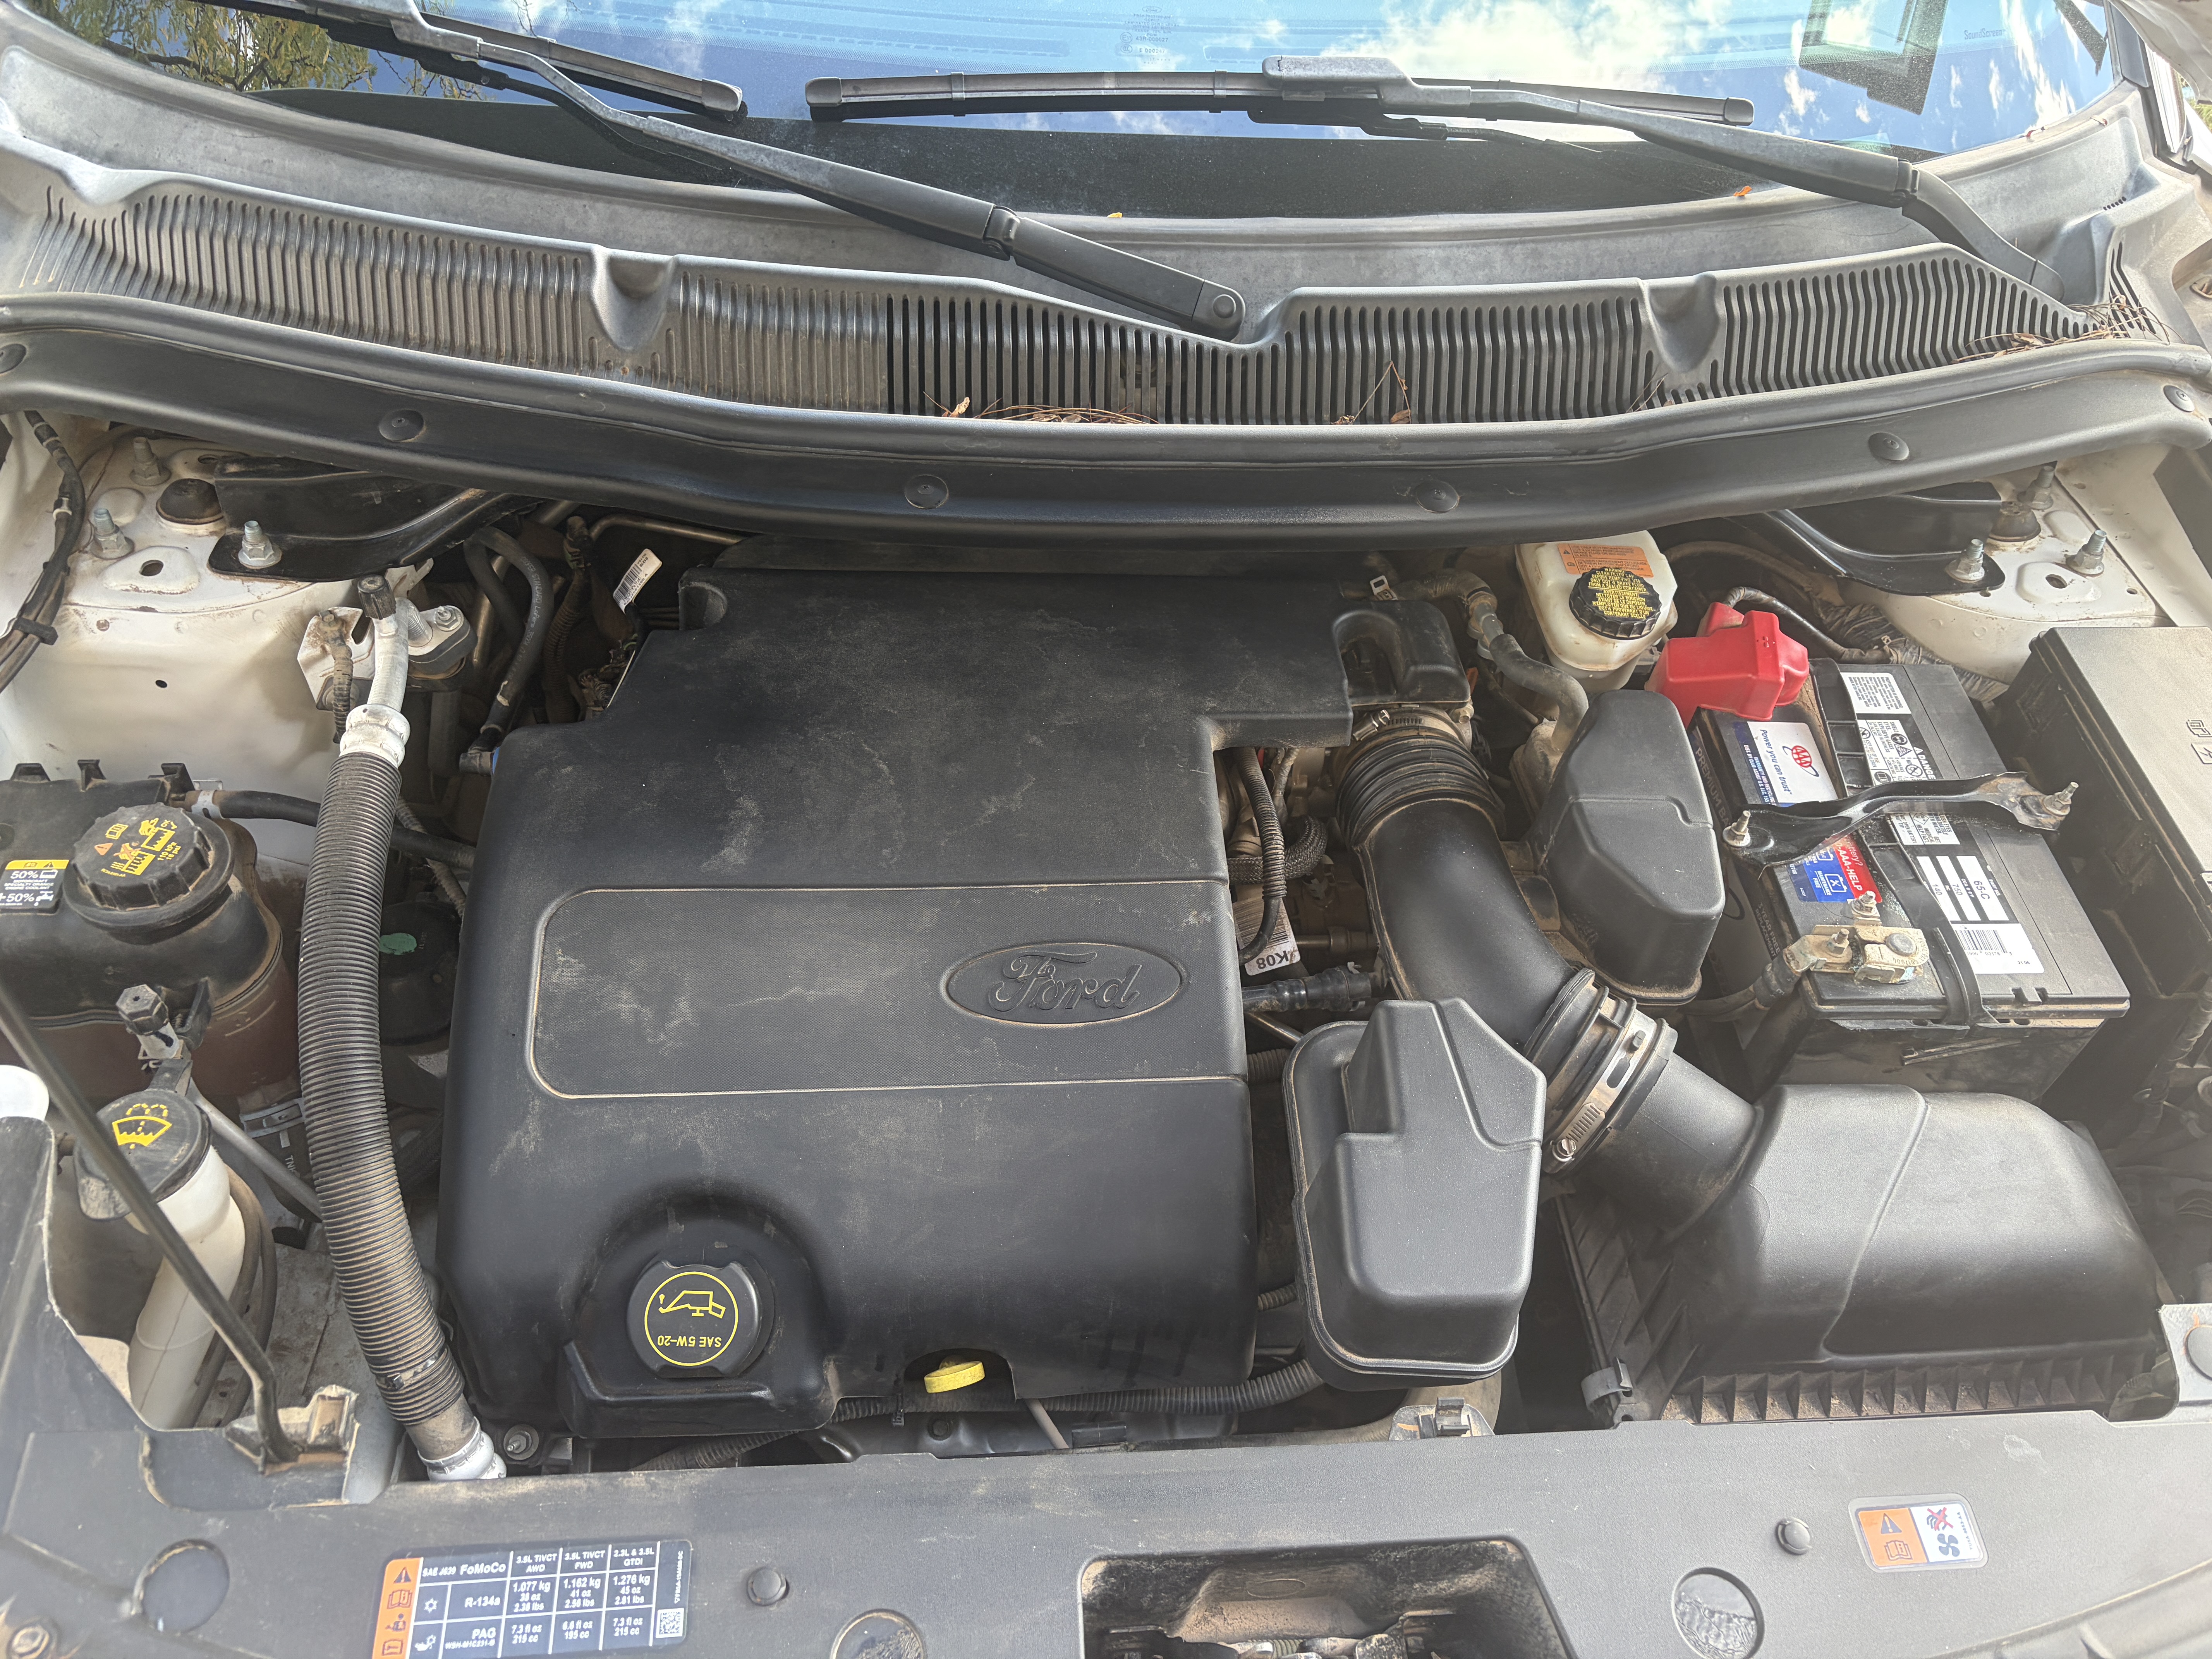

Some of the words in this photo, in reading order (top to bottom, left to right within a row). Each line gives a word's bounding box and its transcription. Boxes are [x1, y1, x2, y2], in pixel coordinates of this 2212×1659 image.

[1889, 722, 1899, 732] SHIELD
[1877, 722, 1889, 738] EXPLOSIVE
[1886, 739, 1894, 750] GASES
[1760, 730, 1772, 750] Power
[1766, 750, 1778, 763] you
[1774, 764, 1783, 775] can
[1792, 746, 1812, 768] AAA
[1918, 755, 1936, 780] DANGE
[1696, 747, 1722, 807] PREMIUM
[161, 819, 171, 828] OK
[1917, 824, 1925, 833] HELP
[1934, 814, 1949, 835] MMEDIATELY
[1944, 824, 1952, 832] EYES
[1907, 830, 1917, 843] BATTERY
[1924, 828, 1935, 843] MEDICAL
[158, 851, 169, 860] 110
[165, 842, 177, 852] kPa
[172, 845, 181, 854] psi
[1813, 878, 1821, 888] FREE
[1817, 871, 1832, 896] MAINTENANCE
[1989, 879, 1997, 891] PART
[1932, 884, 1942, 895] 140
[1952, 884, 1963, 895] 750
[1973, 881, 1990, 899] 65-C
[1755, 908, 1776, 957] REPLACEMENT
[1760, 908, 1772, 930] YEAR
[1769, 931, 1781, 953] FREE
[1257, 950, 1289, 969] K08
[988, 951, 1143, 1012] Ford
[658, 1335, 696, 1347] 5W-20
[699, 1336, 722, 1348] SAE
[565, 1552, 580, 1560] 3.5L
[613, 1549, 630, 1557] 2.3L
[639, 1547, 654, 1556] 3.5L
[516, 1555, 532, 1564] 3.5L
[575, 1561, 593, 1570] FWD
[422, 1567, 438, 1577] SAE
[460, 1562, 506, 1575] FoMoCo
[526, 1564, 545, 1573] AWD
[563, 1577, 587, 1589] 1.162
[589, 1577, 601, 1589] kg
[613, 1574, 637, 1585] 1.276
[639, 1574, 651, 1586] kg
[513, 1581, 537, 1592] 1.077
[539, 1580, 551, 1593] kg
[620, 1586, 630, 1594] 45
[570, 1589, 580, 1598] 41
[632, 1595, 644, 1604] lbs
[465, 1595, 501, 1608] R-134a
[532, 1602, 544, 1611] lbs
[582, 1598, 595, 1607] lbs
[613, 1617, 625, 1626] 7.3
[633, 1618, 643, 1626] oz
[472, 1627, 496, 1639] PAG
[512, 1625, 524, 1634] 7.3
[532, 1625, 542, 1633] oz
[614, 1626, 629, 1636] 215
[512, 1634, 527, 1644] 215
[528, 1635, 538, 1643] cc
